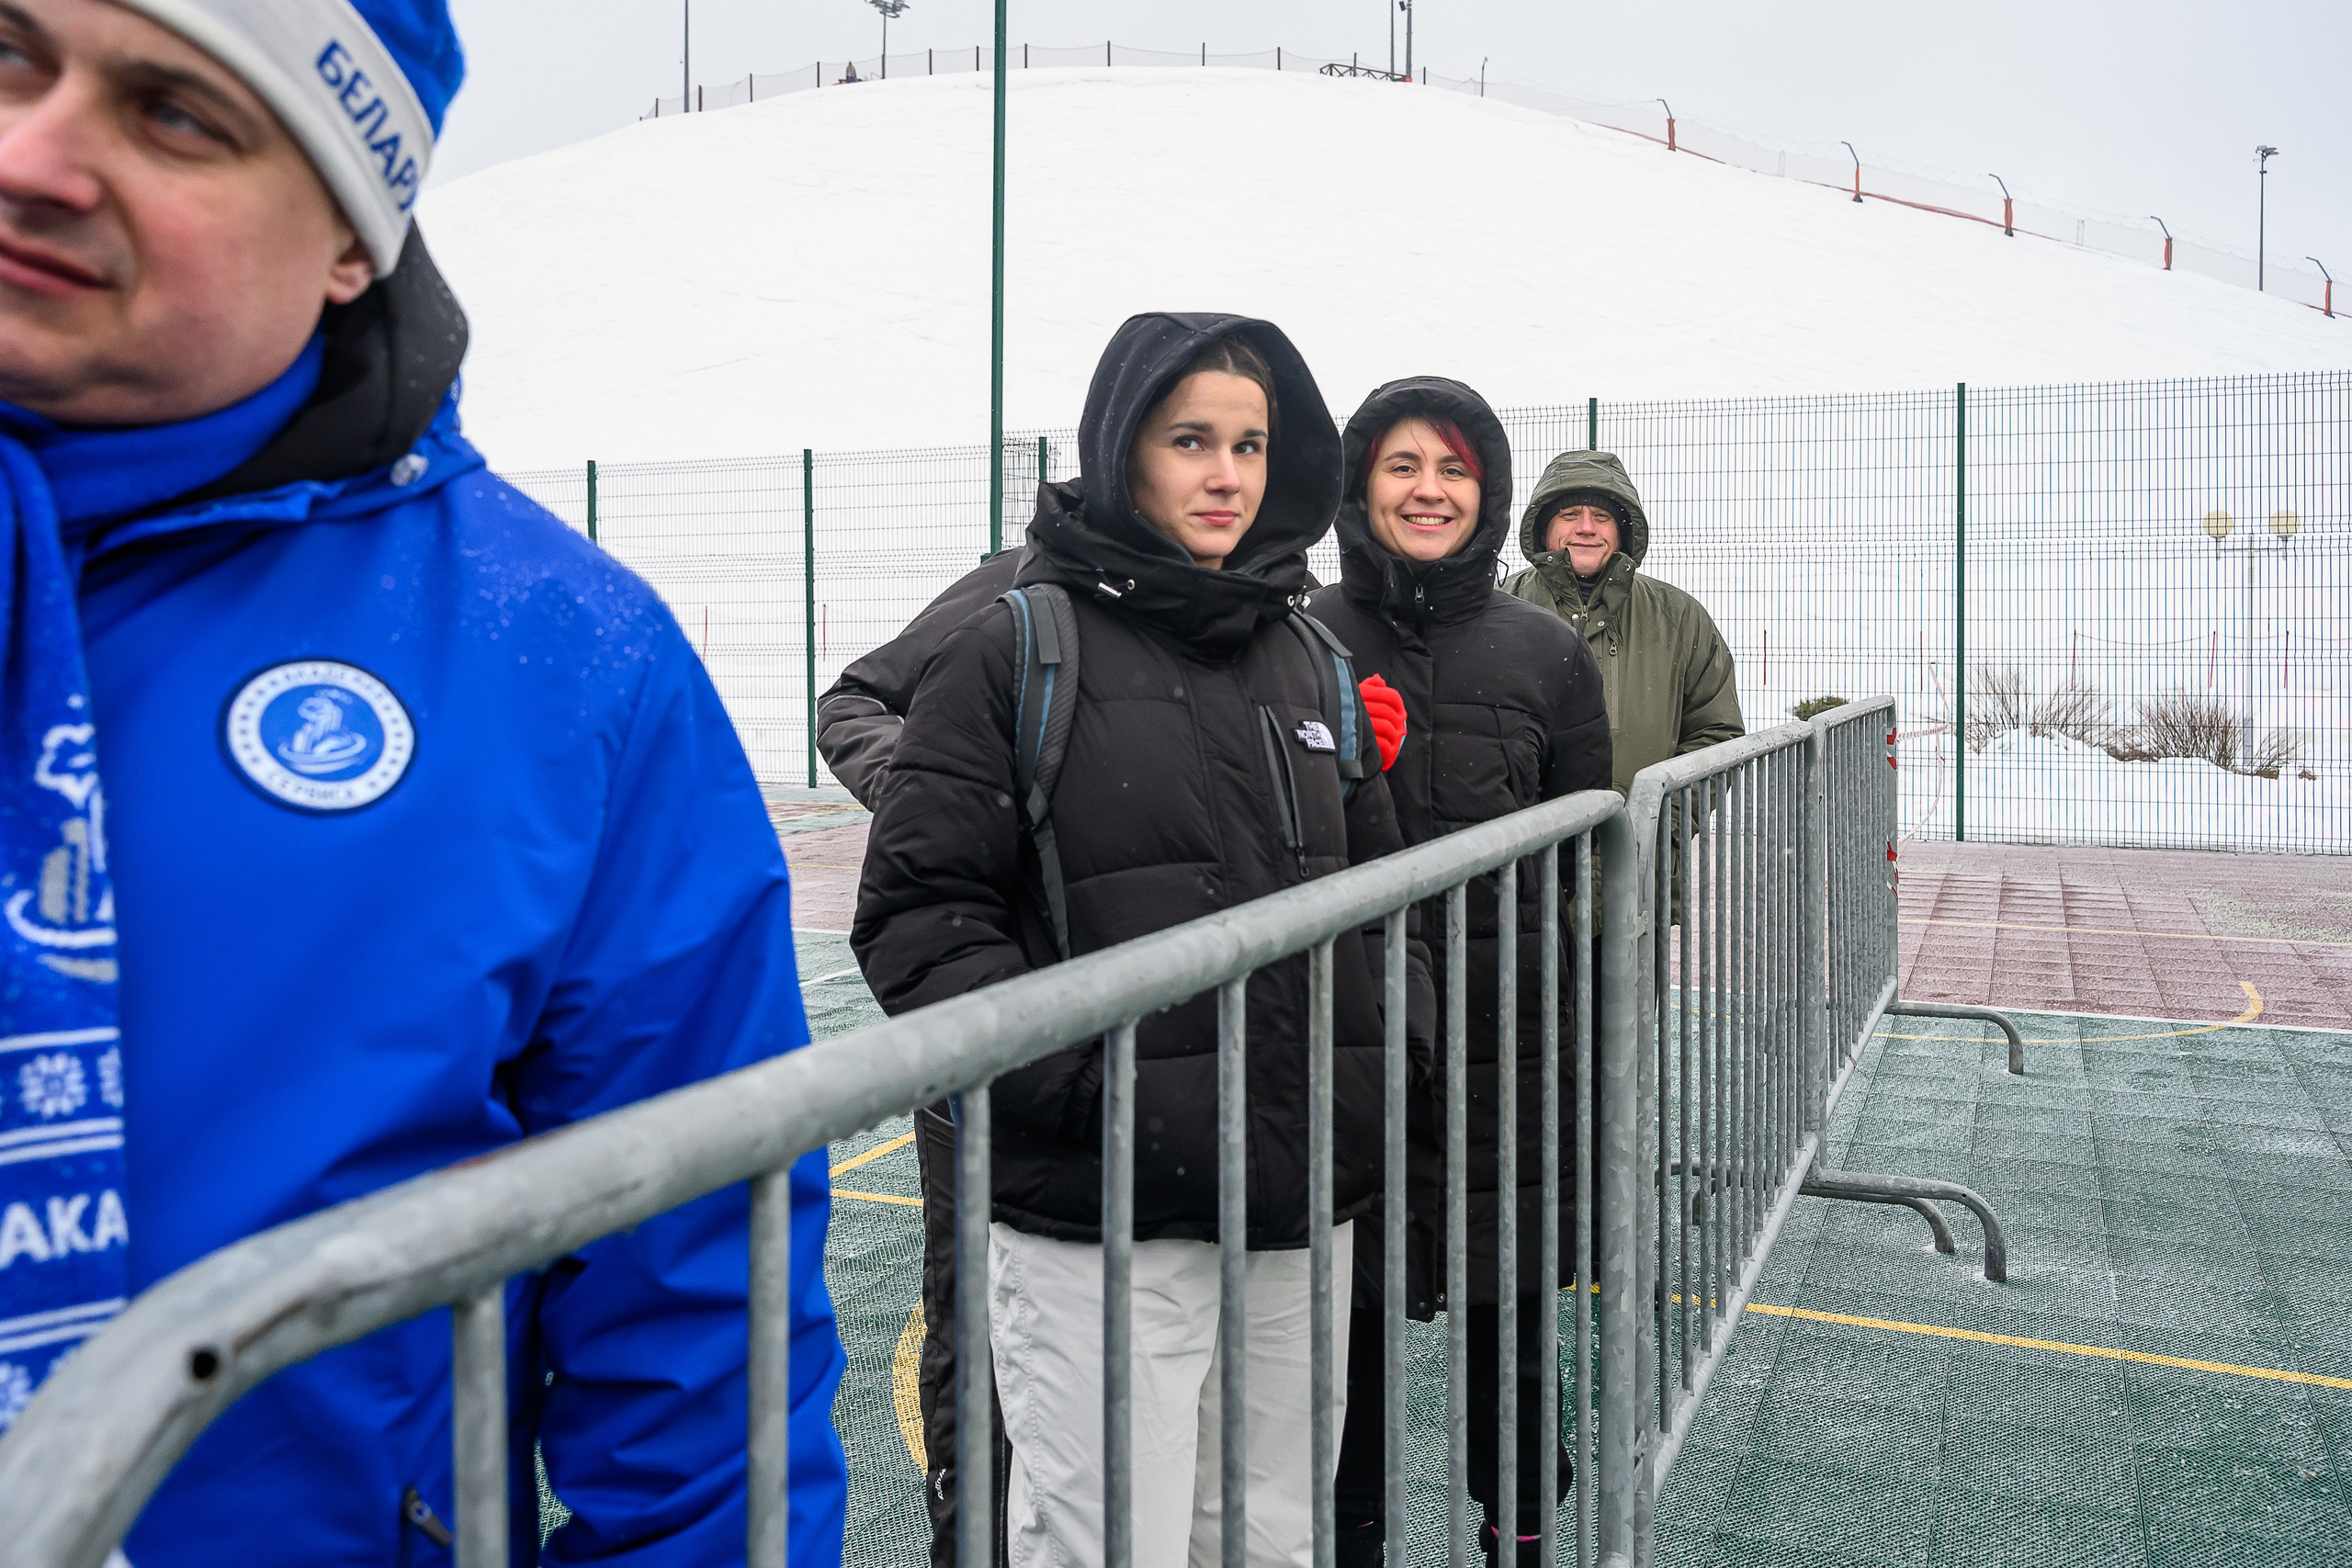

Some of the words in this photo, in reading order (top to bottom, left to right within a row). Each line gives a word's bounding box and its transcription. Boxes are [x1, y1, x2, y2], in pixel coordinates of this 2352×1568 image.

[1303, 721, 1319, 732] THE
[1296, 729, 1321, 740] NORTH
[1306, 739, 1326, 750] FACE
